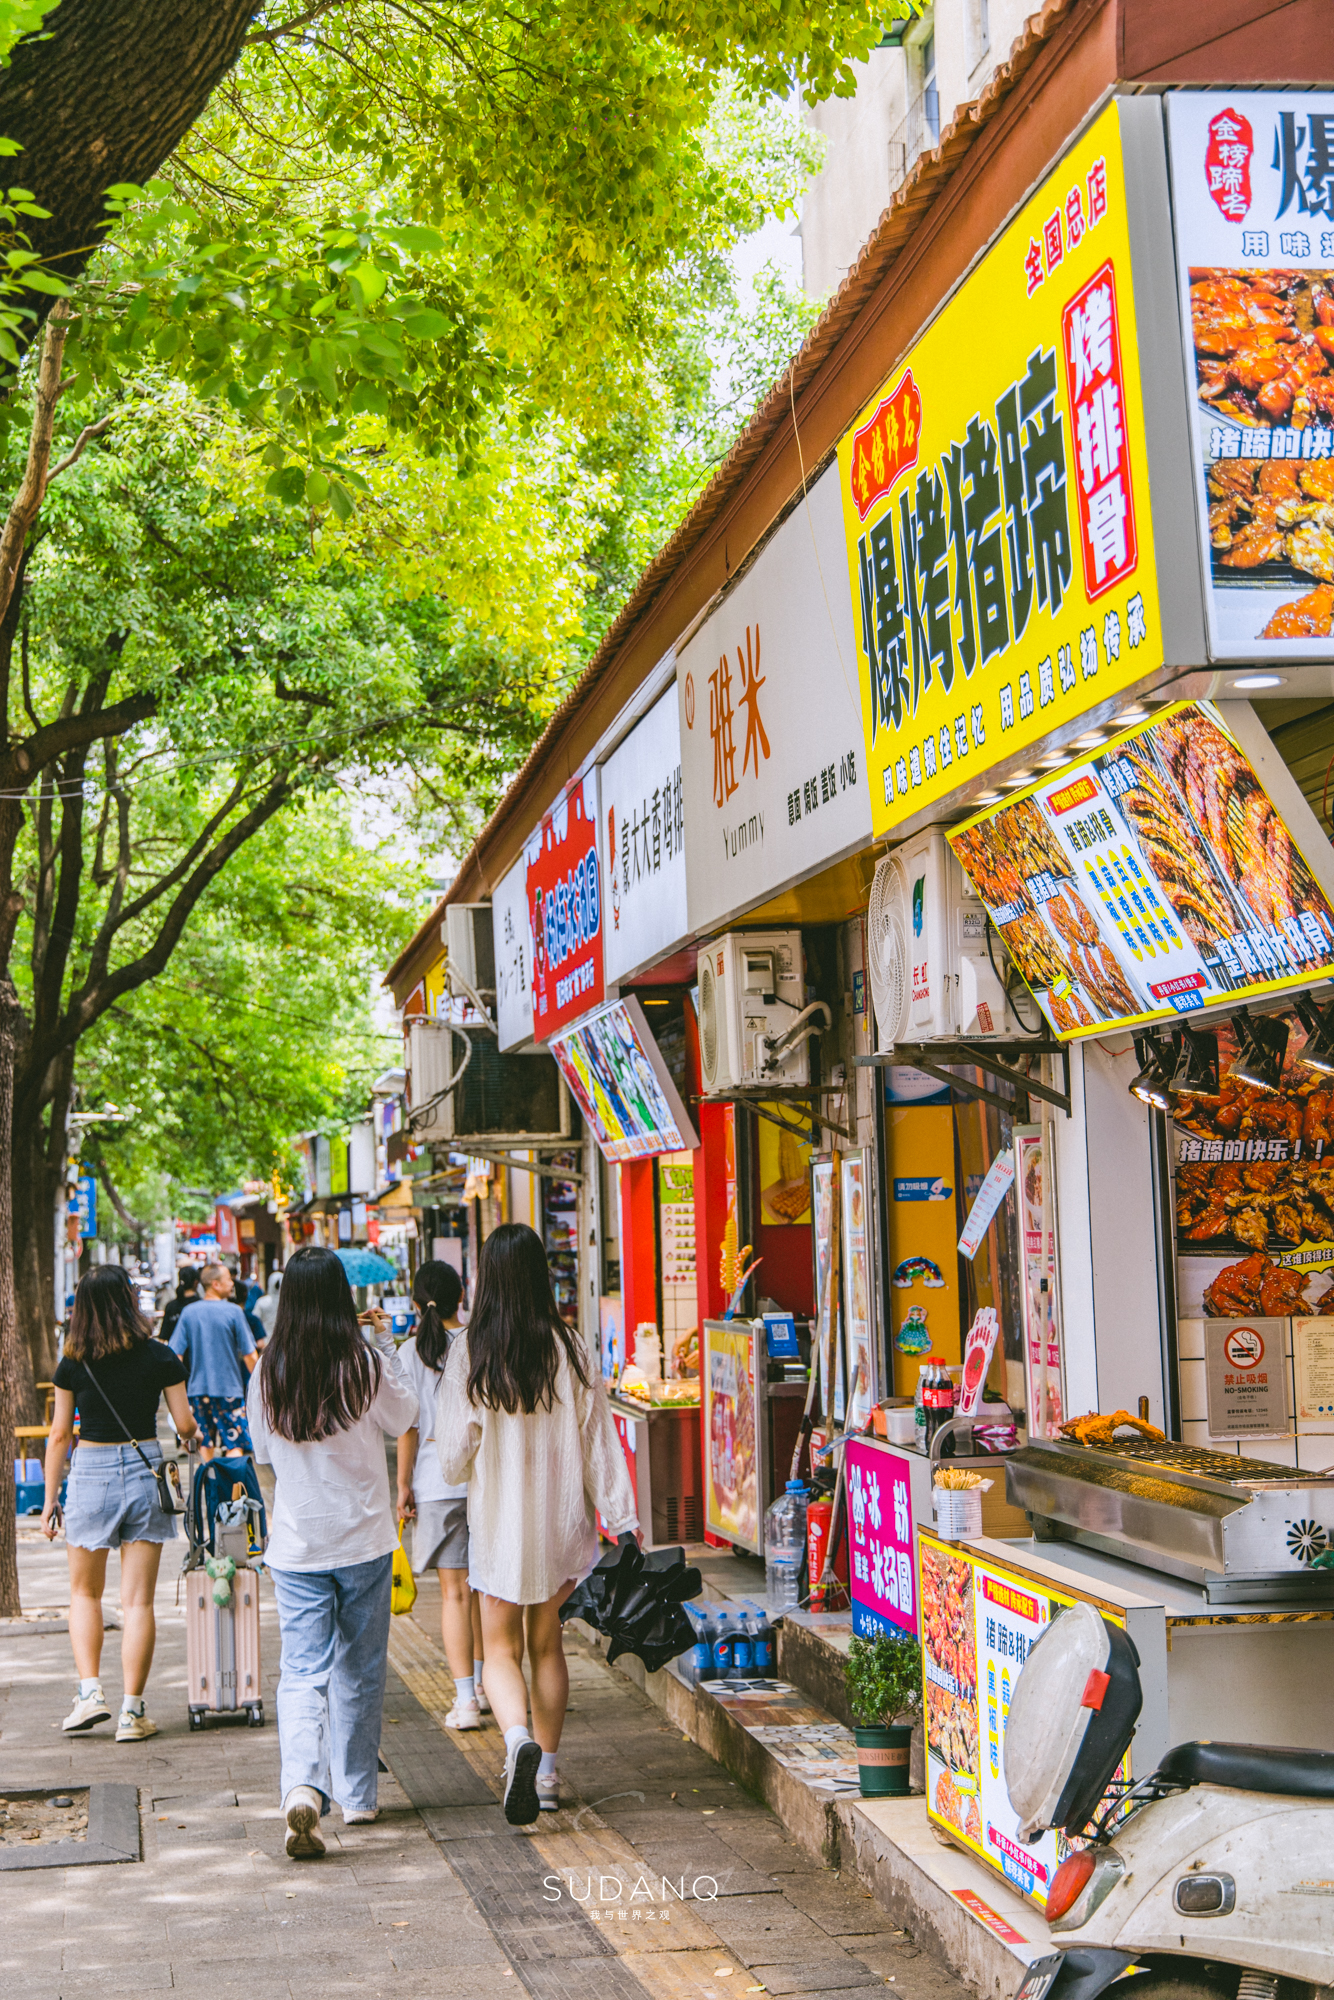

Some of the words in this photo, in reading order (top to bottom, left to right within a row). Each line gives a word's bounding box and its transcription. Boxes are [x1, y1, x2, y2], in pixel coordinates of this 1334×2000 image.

[1211, 117, 1249, 215] 金榜蹄名
[1024, 156, 1107, 299] 全国总店
[857, 394, 915, 499] 金榜蹄名
[1069, 283, 1128, 584] 烤排骨
[1210, 426, 1334, 458] 猪蹄的快
[858, 344, 1072, 750] 爆烤猪蹄
[708, 623, 771, 808] 雅米
[883, 703, 985, 806] 用味道锁住记忆
[1000, 592, 1146, 731] 用品质弘扬传承
[840, 750, 857, 791] 小吃
[1100, 757, 1139, 798] 烤排骨
[723, 810, 764, 860] Yummy
[1063, 808, 1117, 853] 猪蹄&排骨
[912, 987, 930, 1002] CHANGHONG
[913, 962, 928, 986] 长虹
[898, 1182, 928, 1190] 请勿吸烟
[1224, 1373, 1268, 1385] 禁止吸烟
[1225, 1386, 1268, 1394] NO-SMOKING
[866, 1470, 908, 1544] 冰粉
[870, 1538, 913, 1616] 冰汤圆
[986, 1616, 1034, 1666] 猪蹄&排
[996, 1832, 1038, 1874] 抖音/小红书/快手
[1005, 1855, 1031, 1889] 推荐美食
